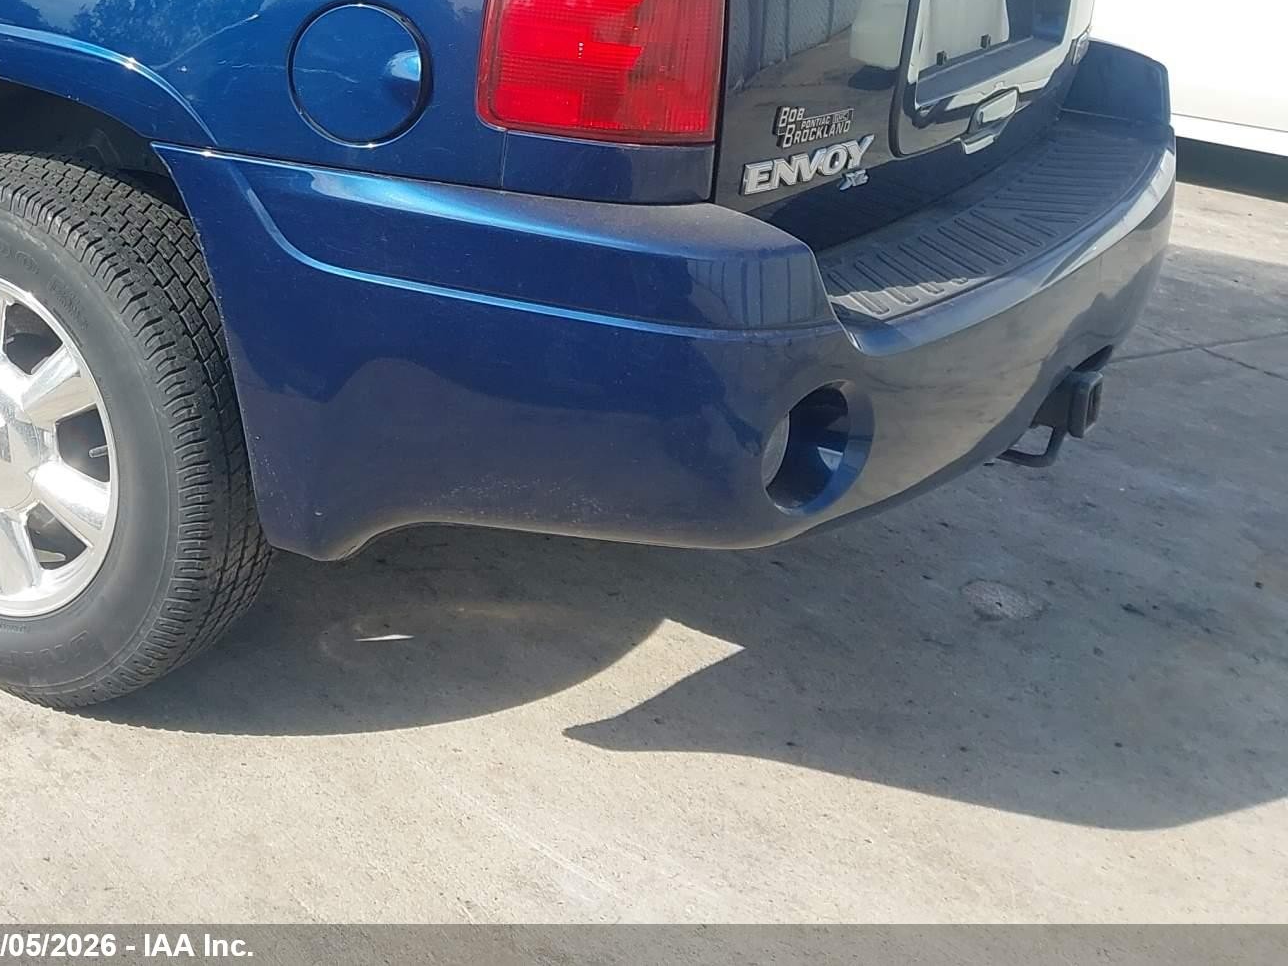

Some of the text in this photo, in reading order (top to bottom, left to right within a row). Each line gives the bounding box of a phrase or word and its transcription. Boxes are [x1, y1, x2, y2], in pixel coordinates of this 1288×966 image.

[779, 107, 805, 127] BOB
[800, 116, 831, 130] PONTIAC
[783, 121, 851, 148] BROCKLAND
[743, 134, 875, 195] ENVOY
